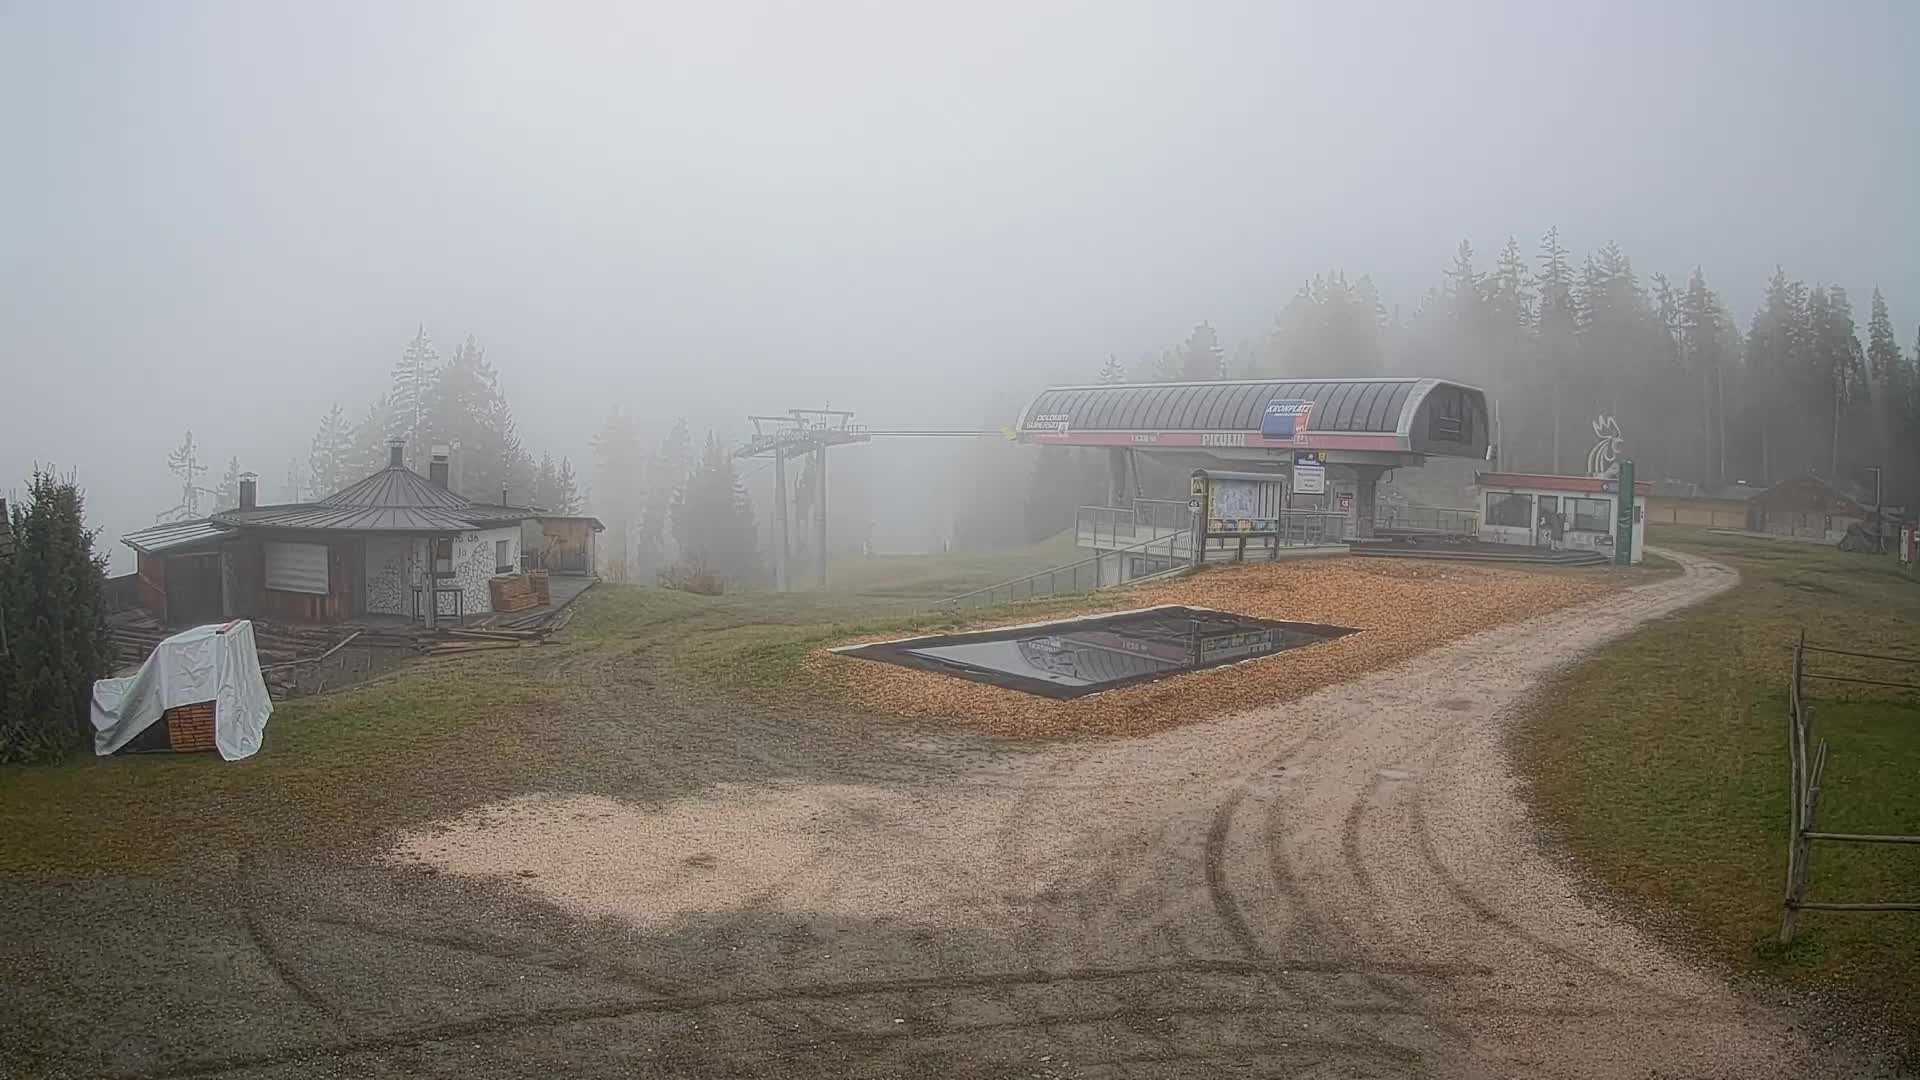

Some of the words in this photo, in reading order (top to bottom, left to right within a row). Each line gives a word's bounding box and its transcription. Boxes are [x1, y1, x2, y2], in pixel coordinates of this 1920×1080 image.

[1265, 404, 1312, 413] KRONPLATZ
[1026, 421, 1058, 429] SUPERSKI
[1202, 433, 1246, 446] PICULIN
